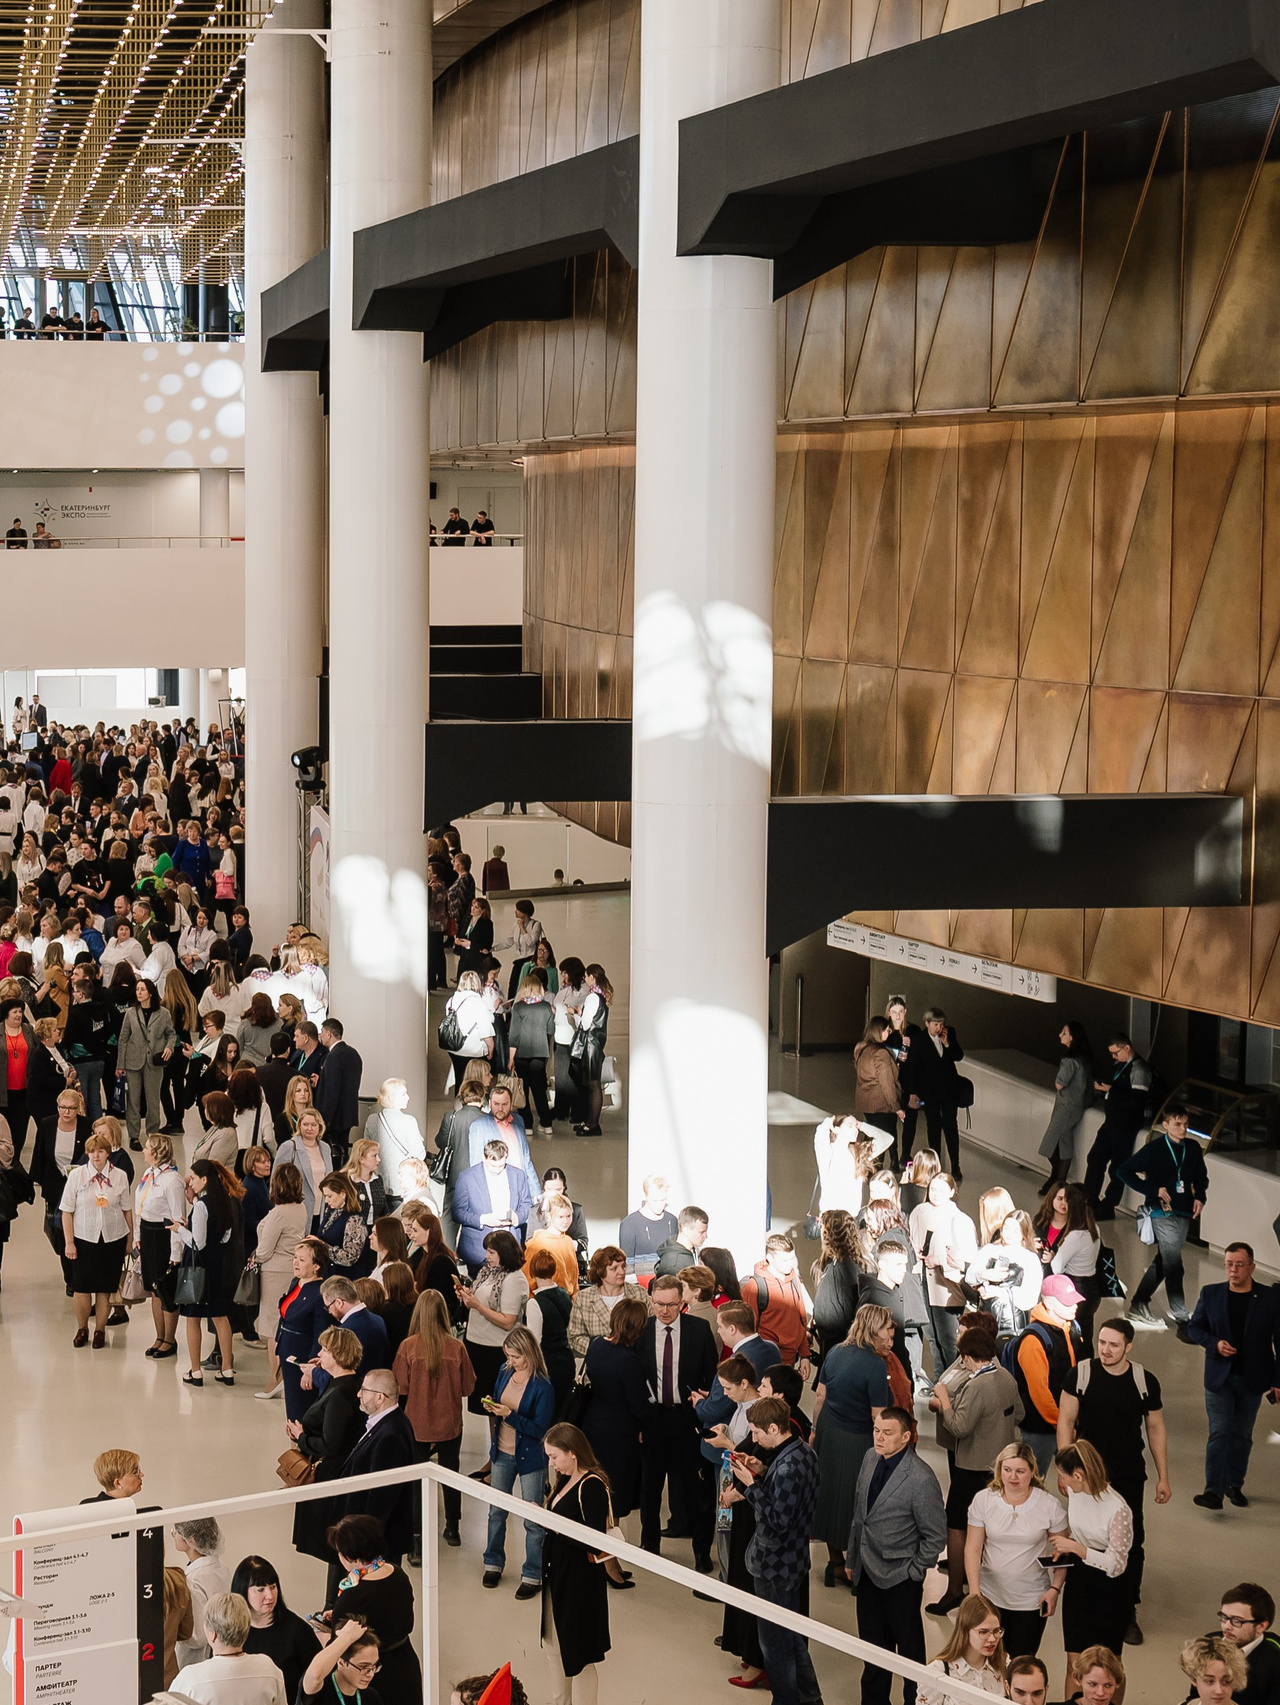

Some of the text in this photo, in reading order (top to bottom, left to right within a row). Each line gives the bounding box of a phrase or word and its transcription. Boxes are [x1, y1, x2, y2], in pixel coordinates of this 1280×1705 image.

[60, 504, 111, 512] ЕКАТЕРИНБУРГ
[142, 1527, 154, 1539] 4
[33, 1573, 59, 1582] Ресторан
[89, 1592, 107, 1601] ЛОЖА
[142, 1583, 154, 1599] 3
[38, 1602, 54, 1610] ундж
[33, 1612, 88, 1626] Переговорная 3.1-3.6
[33, 1627, 92, 1642] Конференц-зал 3.1-3.10
[141, 1642, 155, 1661] 2
[35, 1661, 62, 1672] ПАРТЕР
[35, 1670, 63, 1679] PARTERRE
[35, 1679, 78, 1692] АМФИТЕАТР
[35, 1687, 77, 1700] AMPHITHEATER
